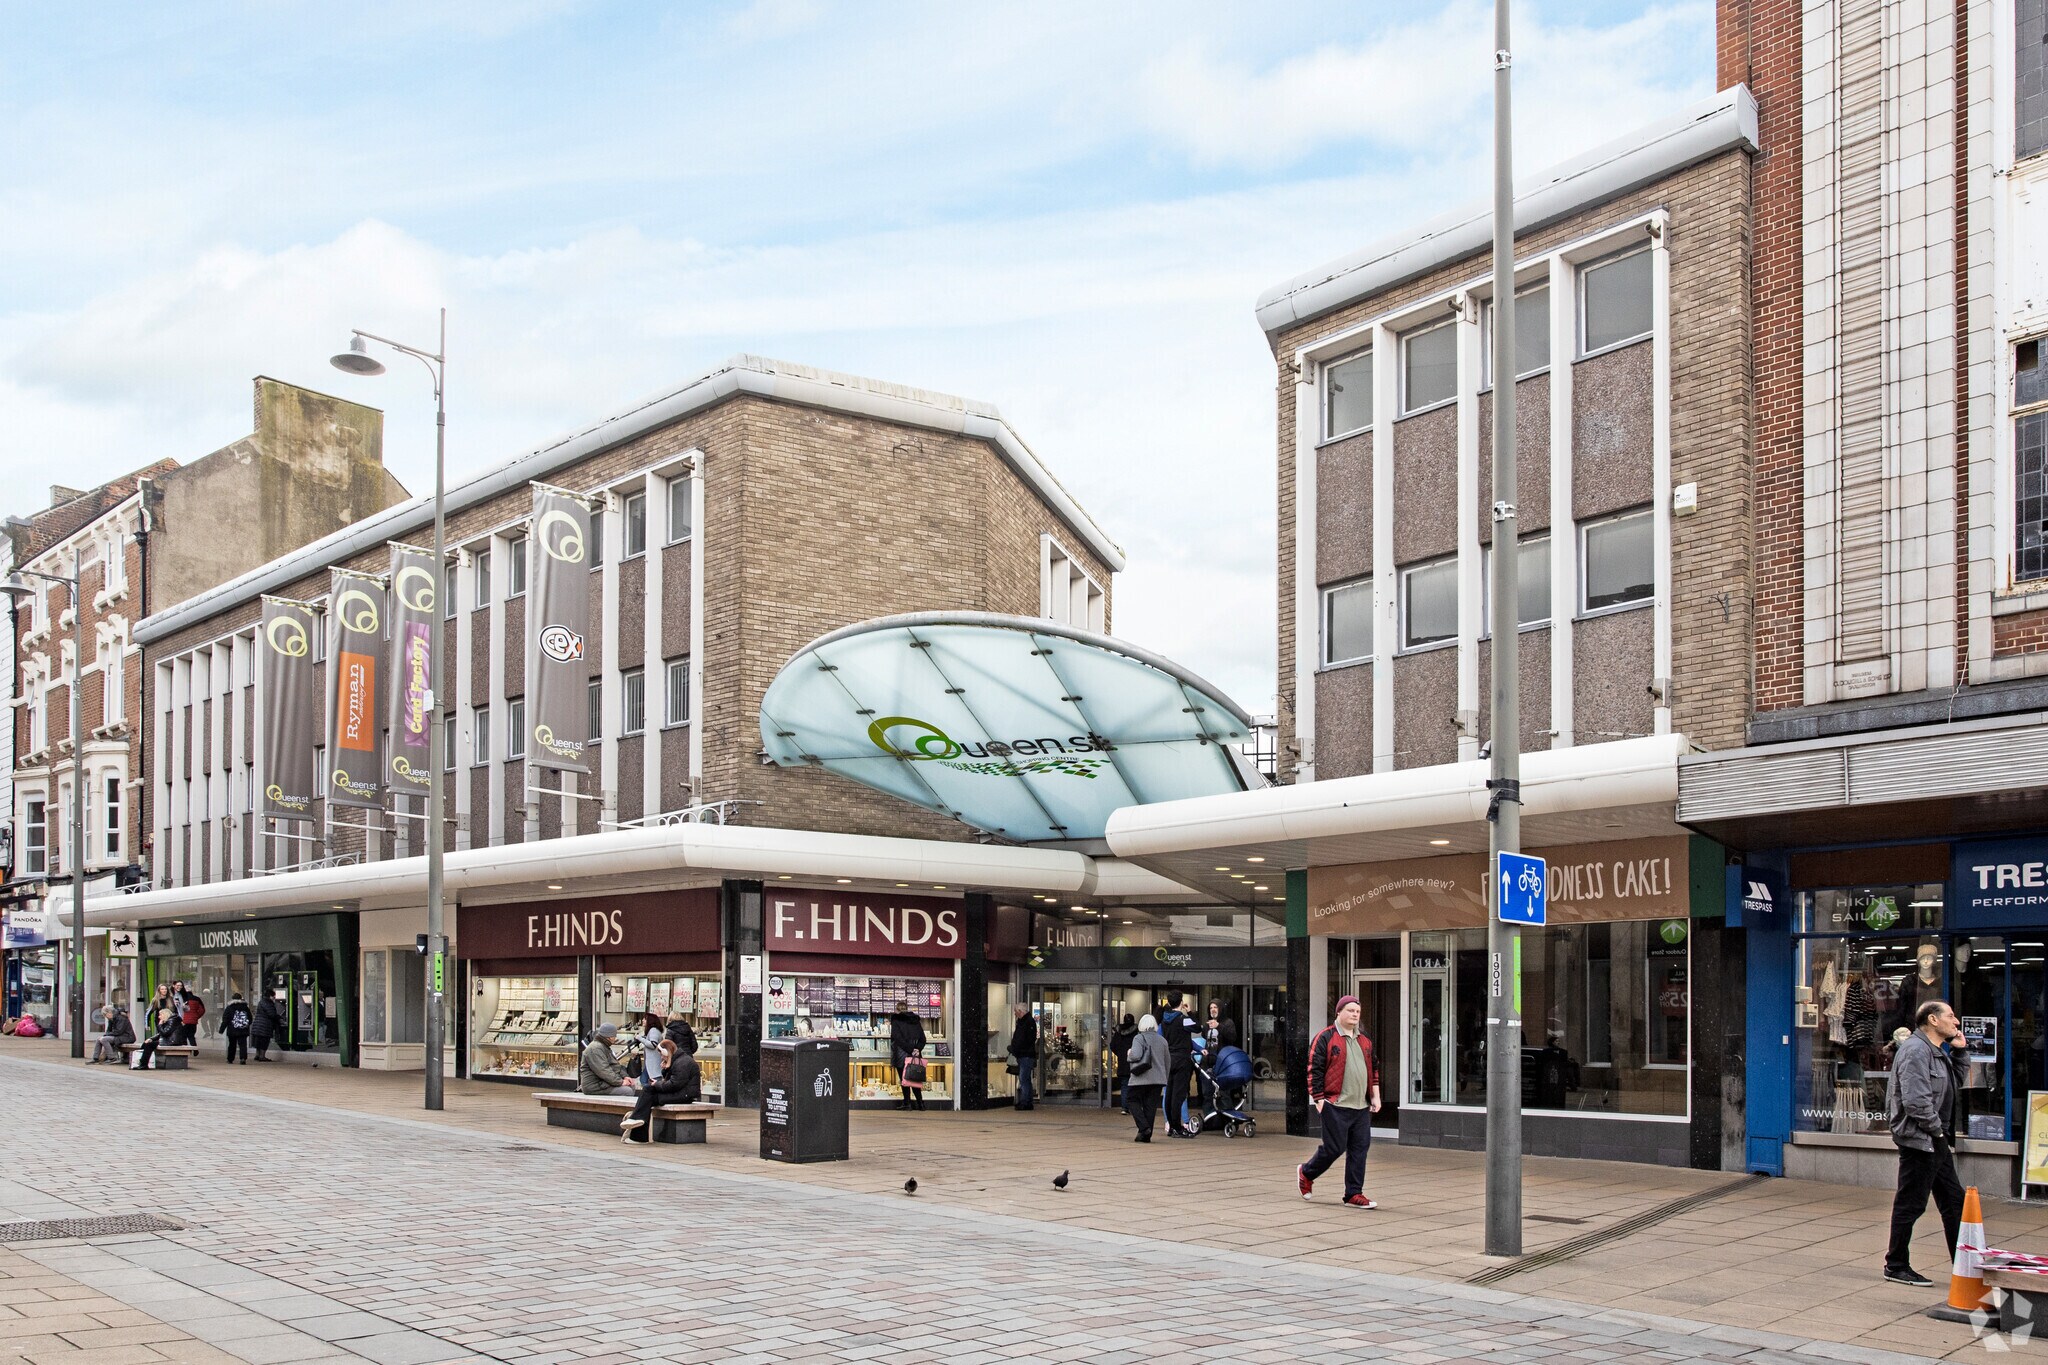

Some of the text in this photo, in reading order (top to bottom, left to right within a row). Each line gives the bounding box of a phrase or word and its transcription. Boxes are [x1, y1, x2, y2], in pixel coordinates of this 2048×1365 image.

[410, 635, 426, 733] Card Factory
[347, 663, 361, 740] Ryman
[1545, 857, 1671, 902] DNESS CAKE!
[1971, 862, 2048, 890] TRE
[1314, 877, 1455, 918] Looking for somewhere new?
[1744, 900, 1773, 913] TRESPASS
[1836, 895, 1896, 907] HIKING
[1831, 911, 1901, 922] SAILING
[200, 928, 259, 949] LLOYDS BANK
[1492, 953, 1501, 996] 19041
[773, 1000, 792, 1010] OFF
[1964, 1026, 1987, 1034] PACT
